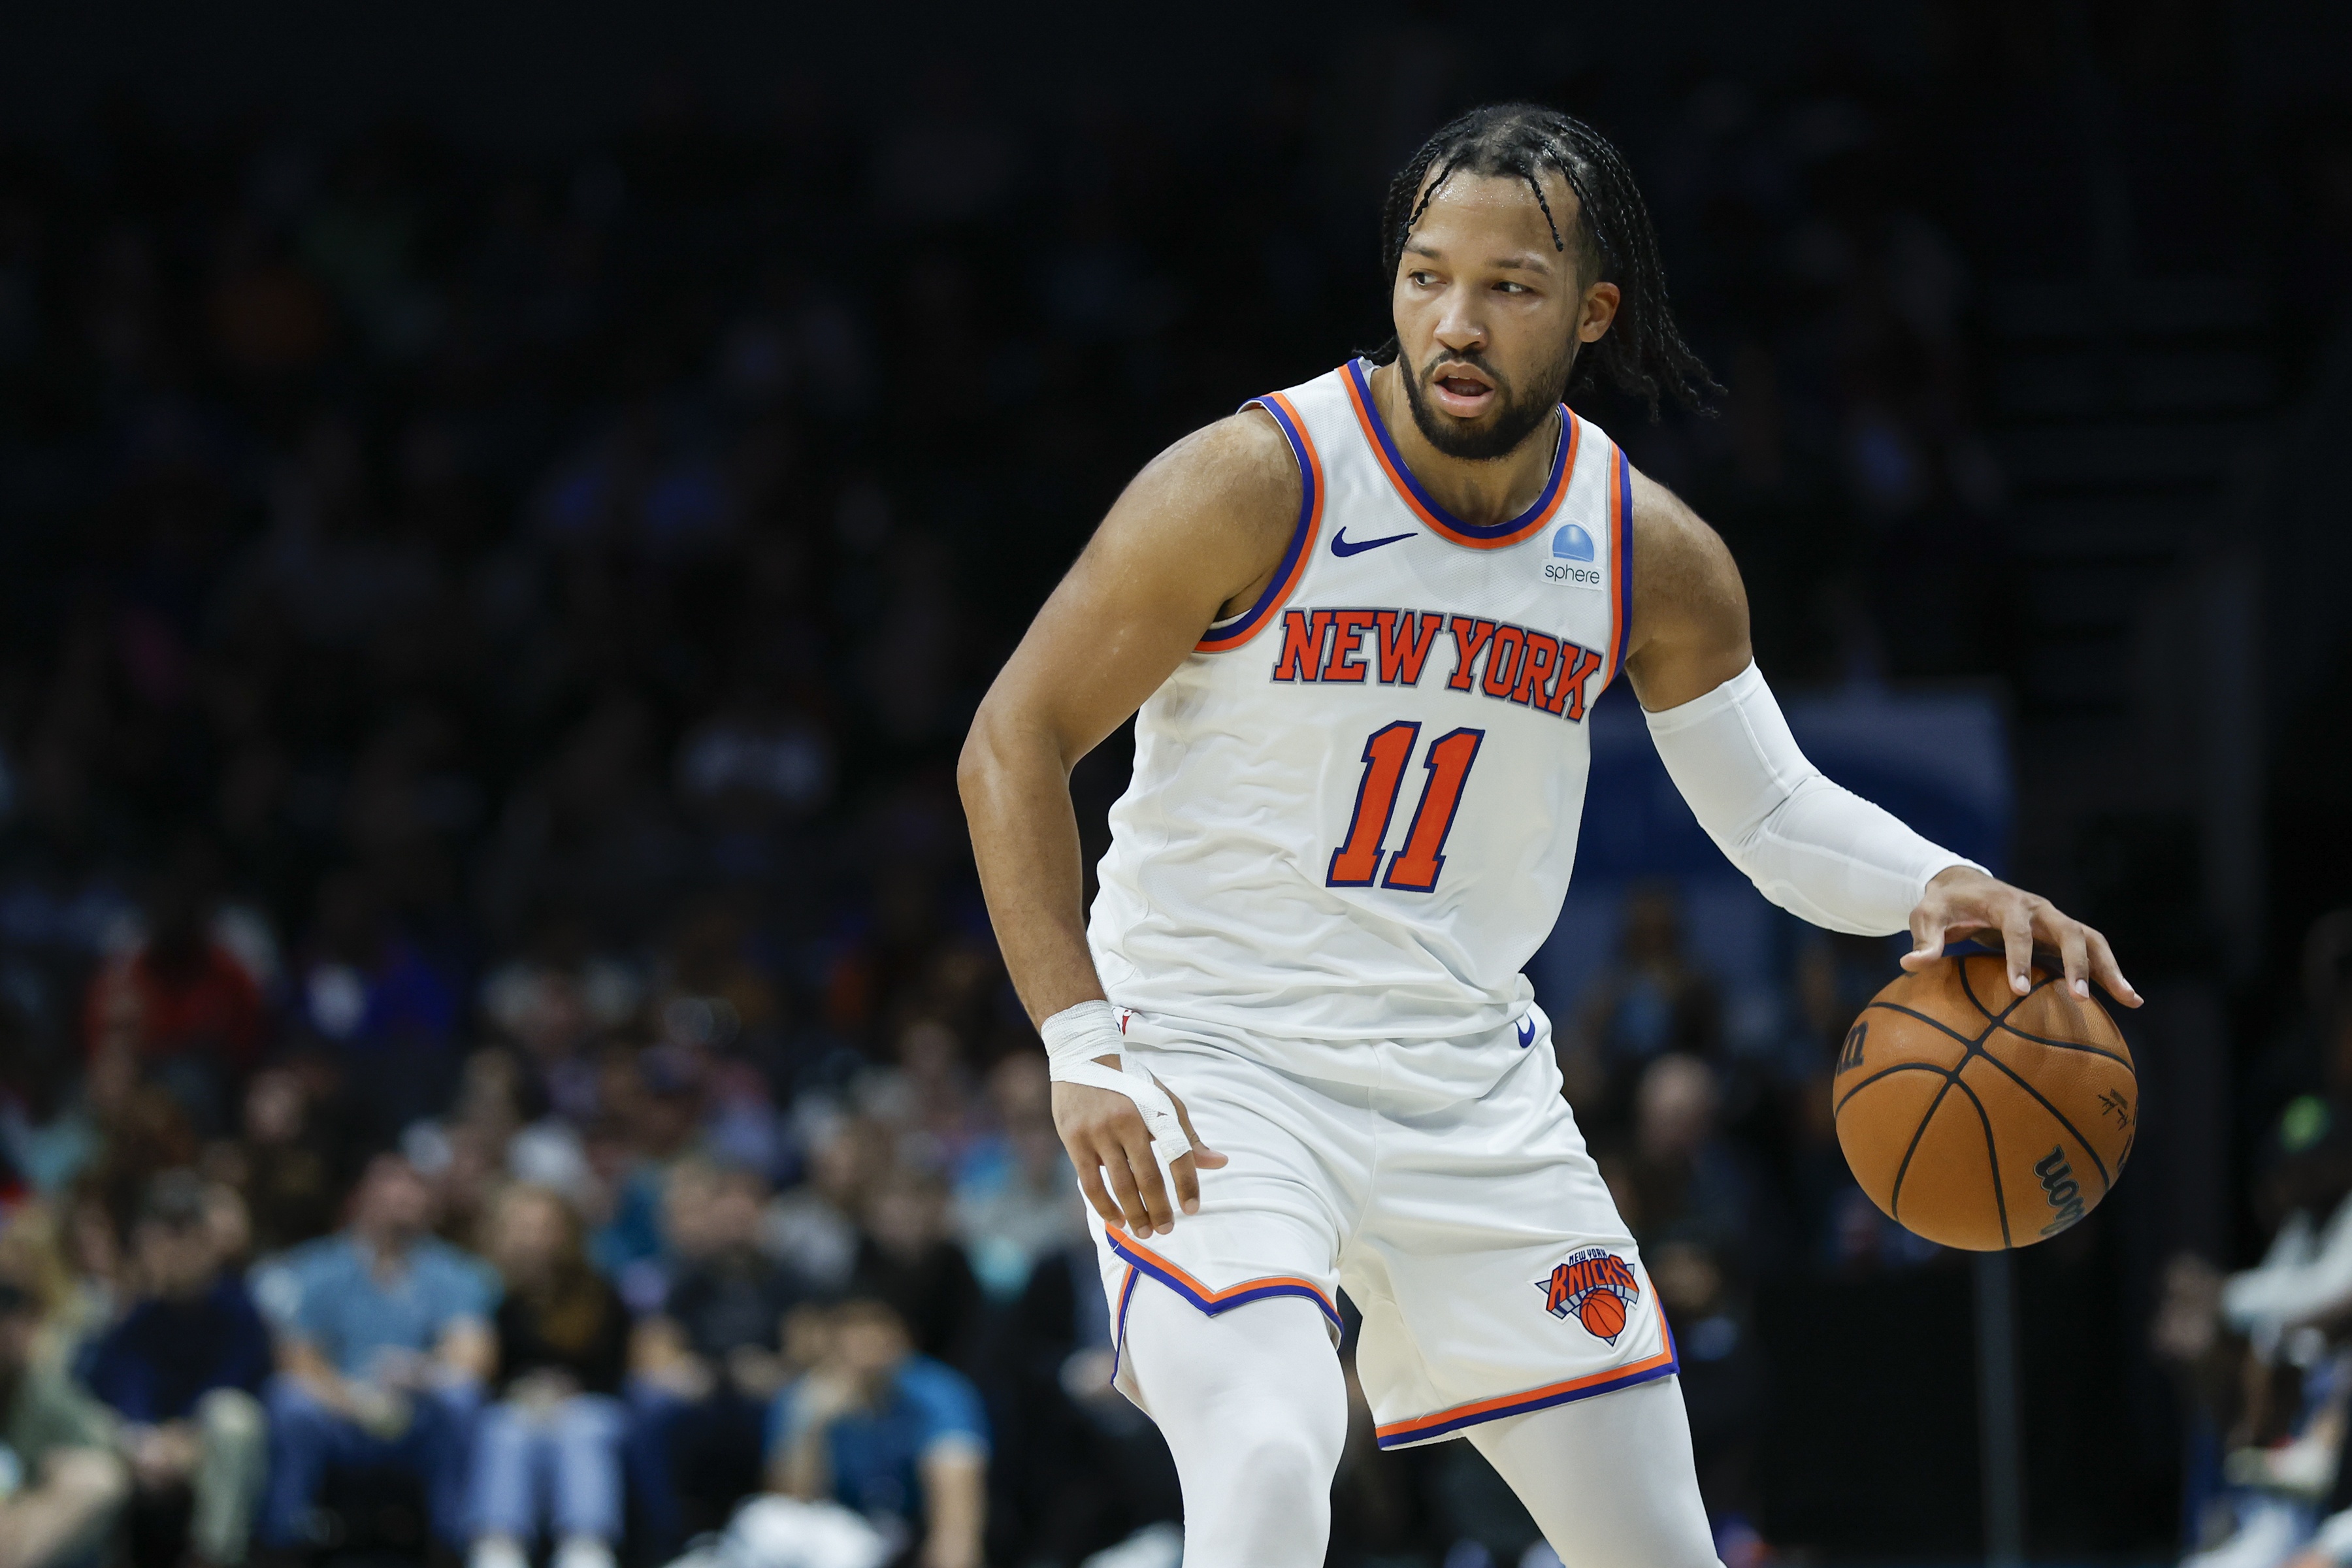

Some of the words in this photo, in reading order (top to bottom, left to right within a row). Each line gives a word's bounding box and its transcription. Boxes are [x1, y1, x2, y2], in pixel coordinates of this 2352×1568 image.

[1544, 564, 1600, 584] sphere
[1272, 608, 1445, 685] NEW
[1445, 615, 1603, 723] YORK
[1326, 720, 1486, 893] 11
[1546, 1254, 1640, 1315] KNICKS
[1569, 1250, 1586, 1265] NEW
[1587, 1248, 1608, 1259] YORK
